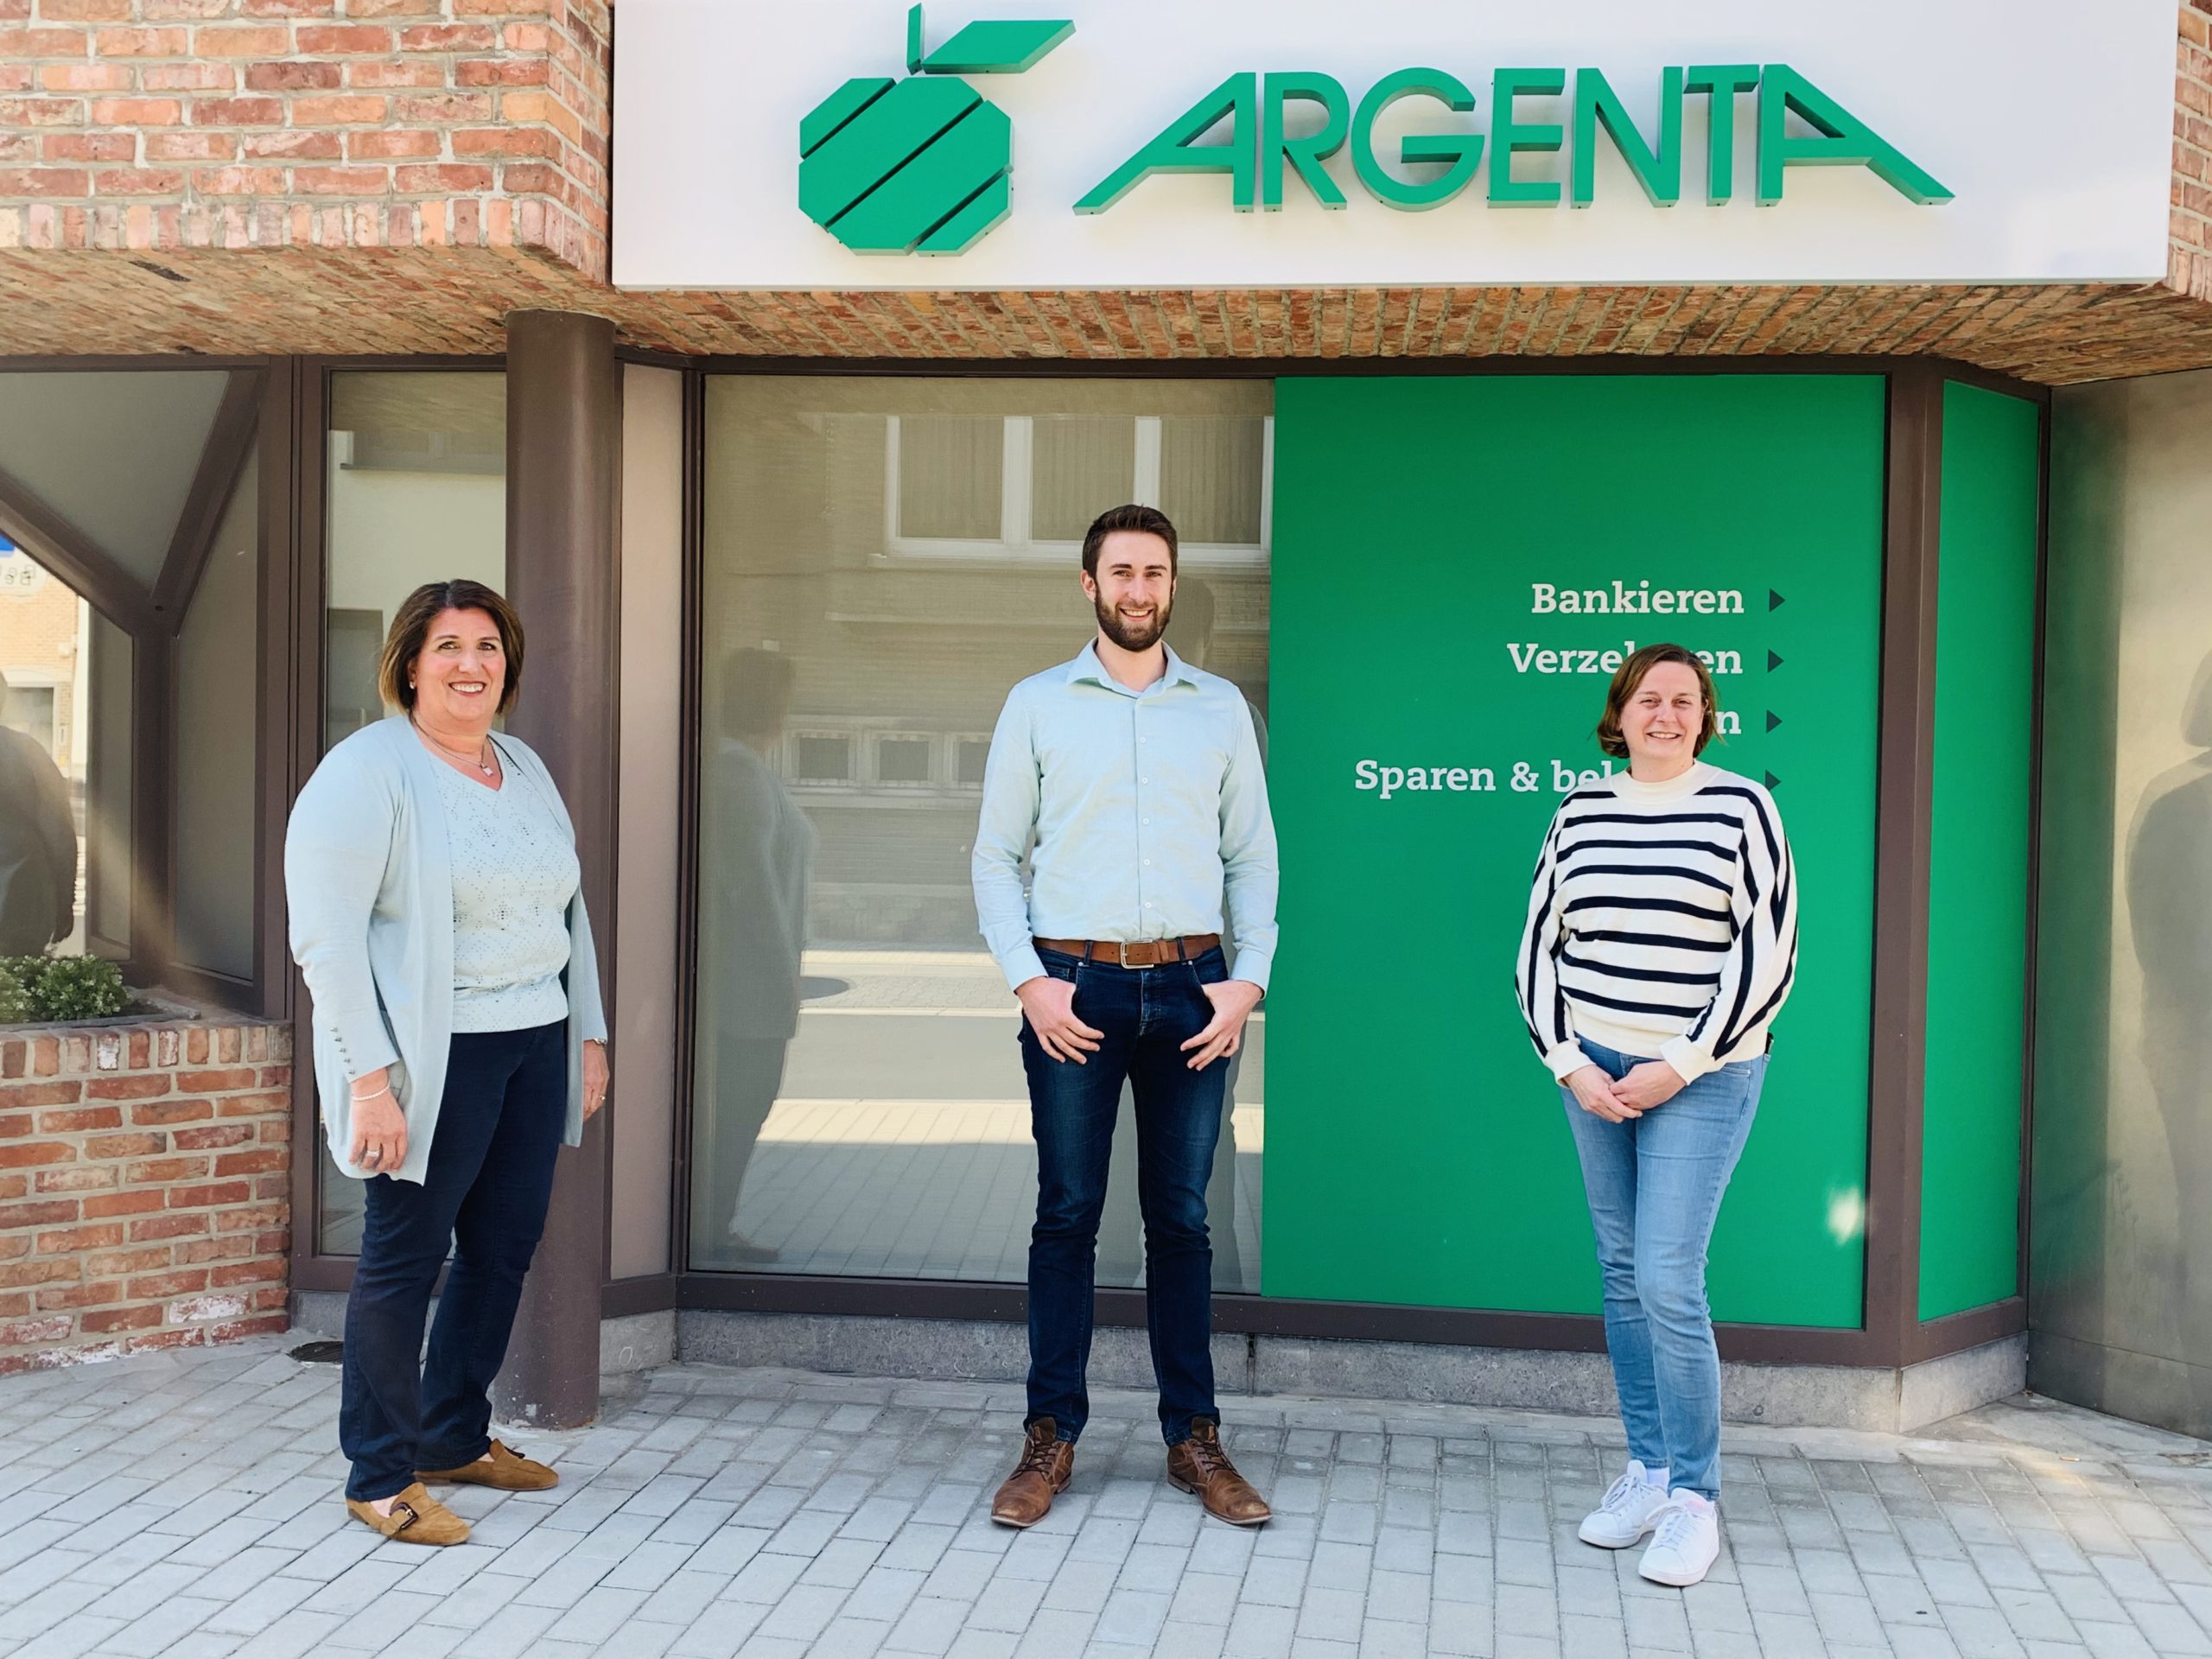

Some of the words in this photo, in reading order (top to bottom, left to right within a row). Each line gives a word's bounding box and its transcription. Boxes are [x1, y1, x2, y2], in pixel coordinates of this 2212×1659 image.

[1073, 63, 1955, 214] ARGENTA
[1531, 580, 1745, 614] Bankieren
[1355, 760, 1497, 799] Sparen
[1510, 761, 1539, 792] &
